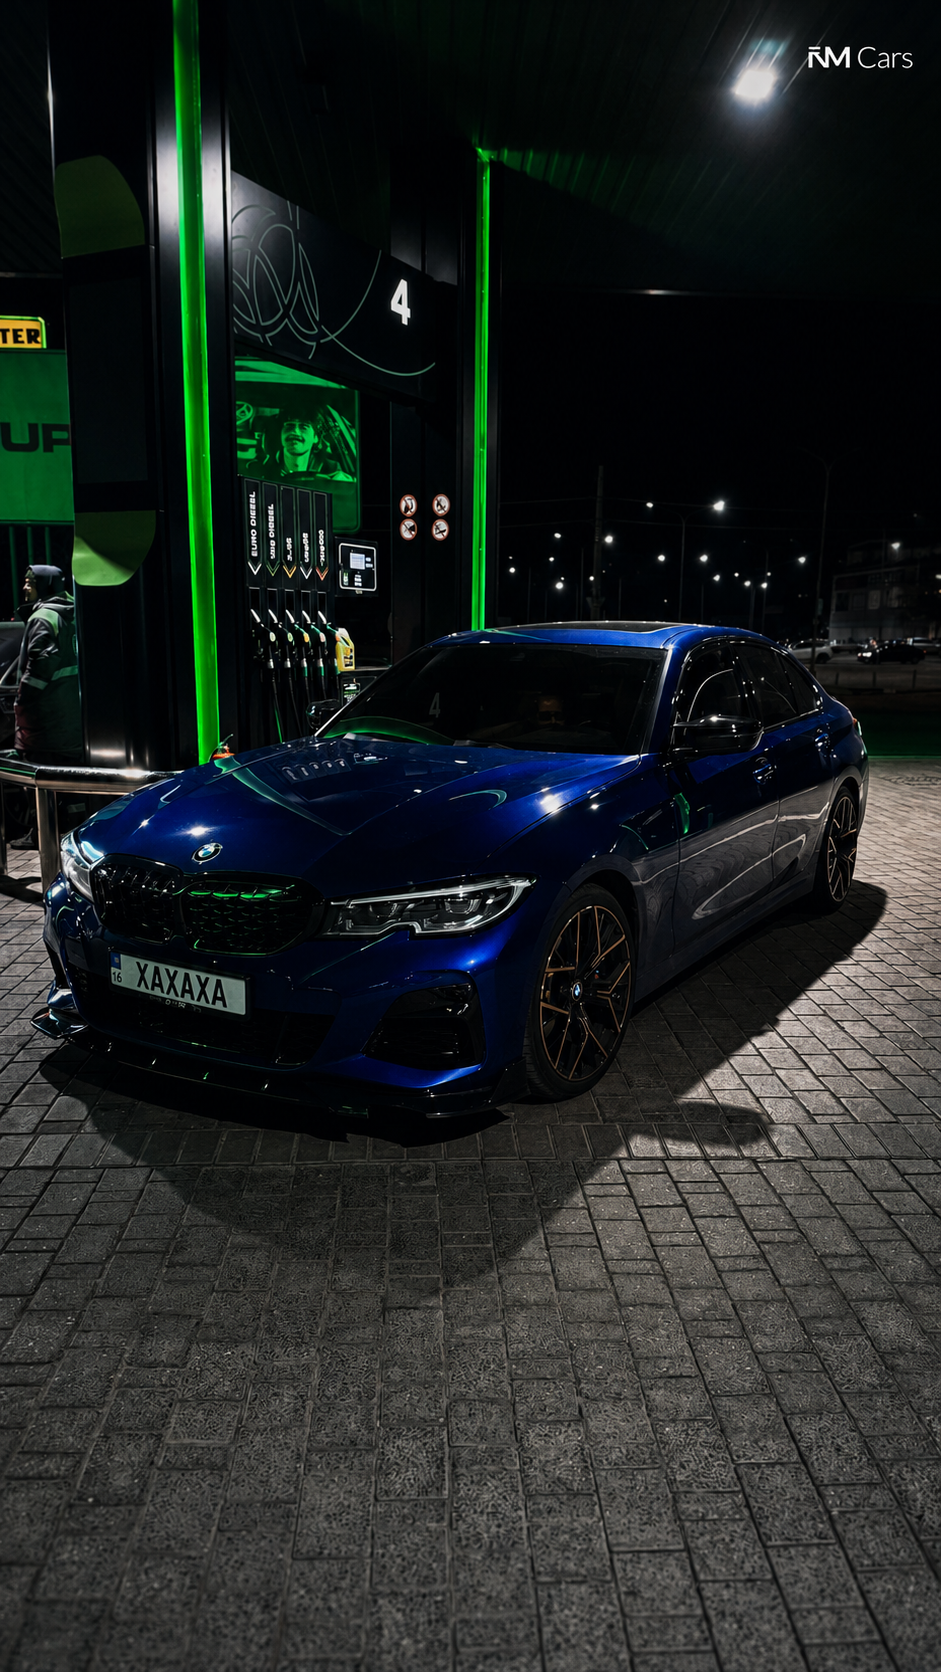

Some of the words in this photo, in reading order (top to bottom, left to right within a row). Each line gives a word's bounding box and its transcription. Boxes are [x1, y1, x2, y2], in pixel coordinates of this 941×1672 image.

[391, 278, 411, 326] 4
[112, 971, 122, 983] 16
[136, 961, 227, 1008] XAXAXA
